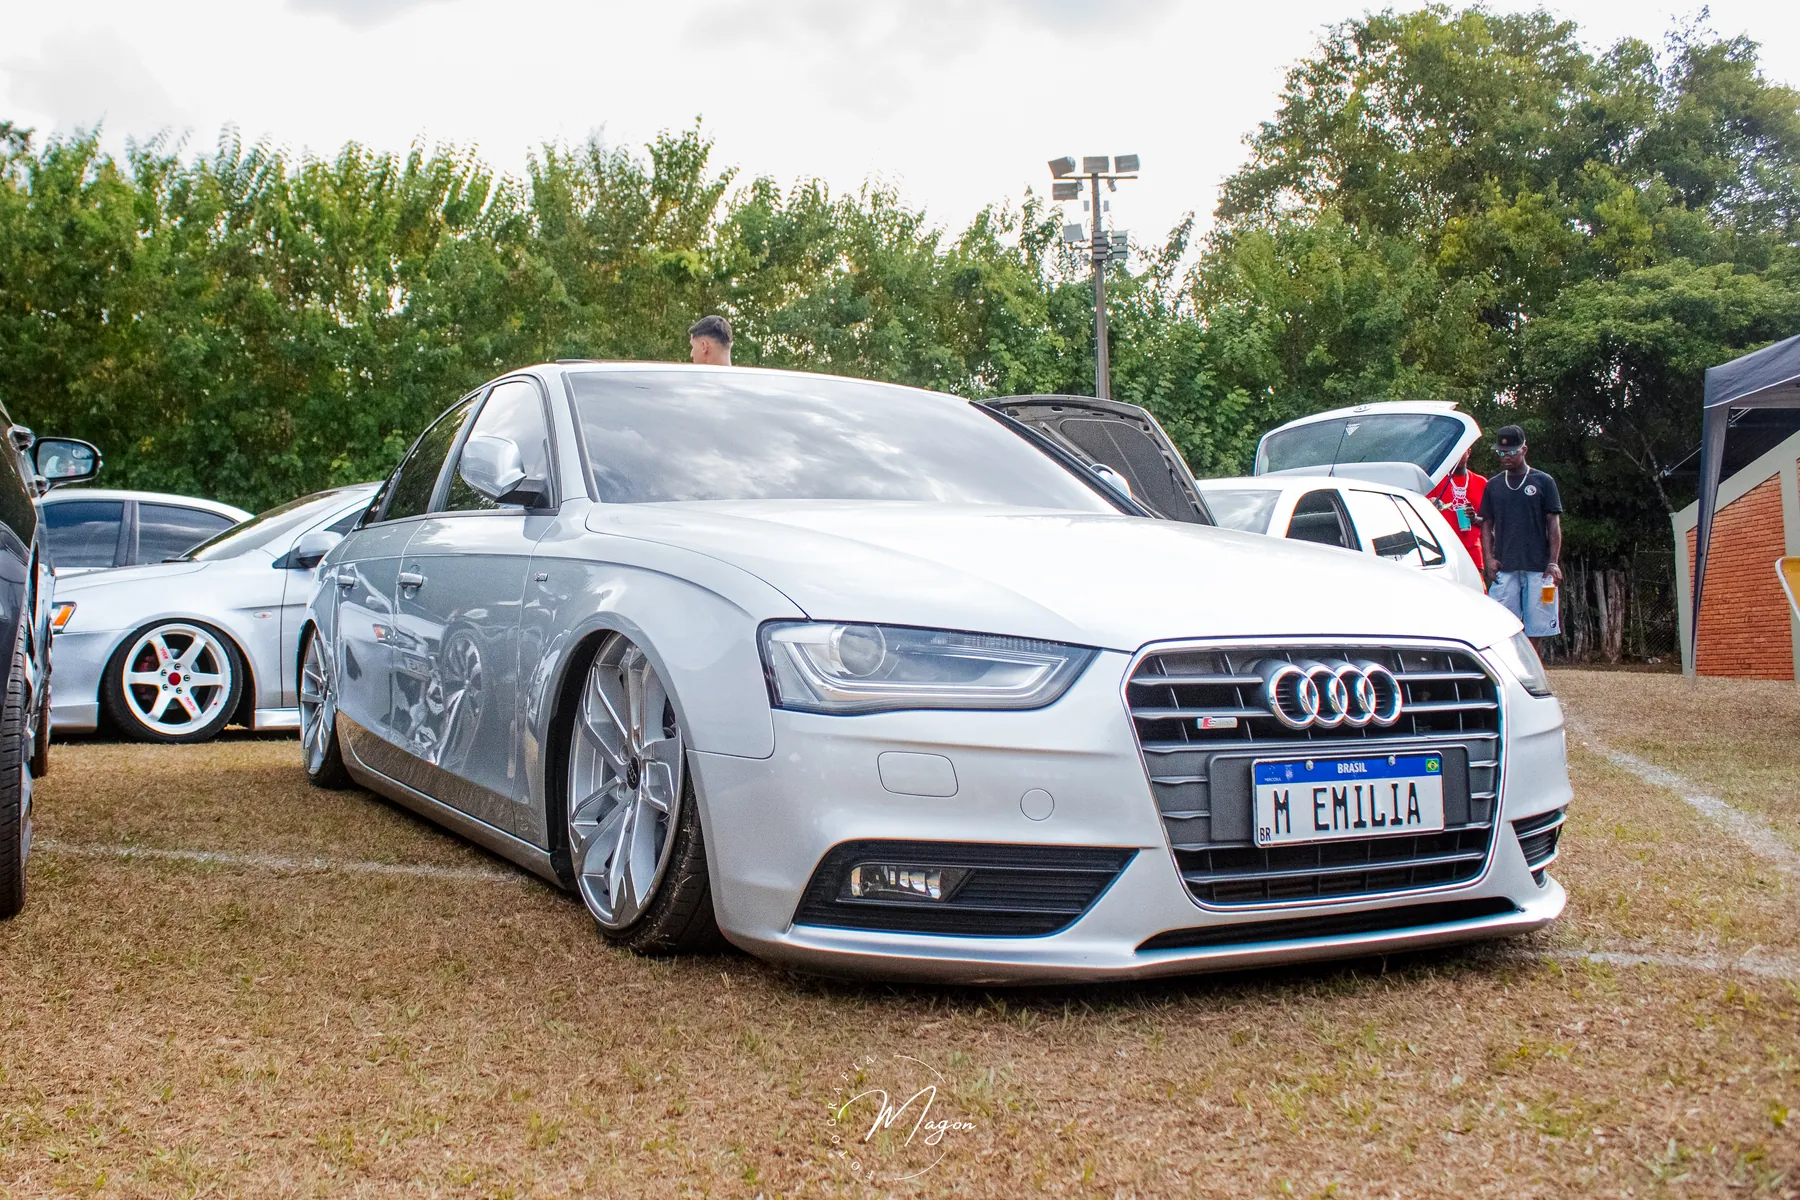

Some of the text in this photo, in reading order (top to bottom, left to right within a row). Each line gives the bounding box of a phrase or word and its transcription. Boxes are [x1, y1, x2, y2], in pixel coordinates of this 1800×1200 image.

[1337, 762, 1368, 774] BRASIL
[1273, 780, 1421, 834] M EMILIA
[1259, 827, 1271, 842] BR
